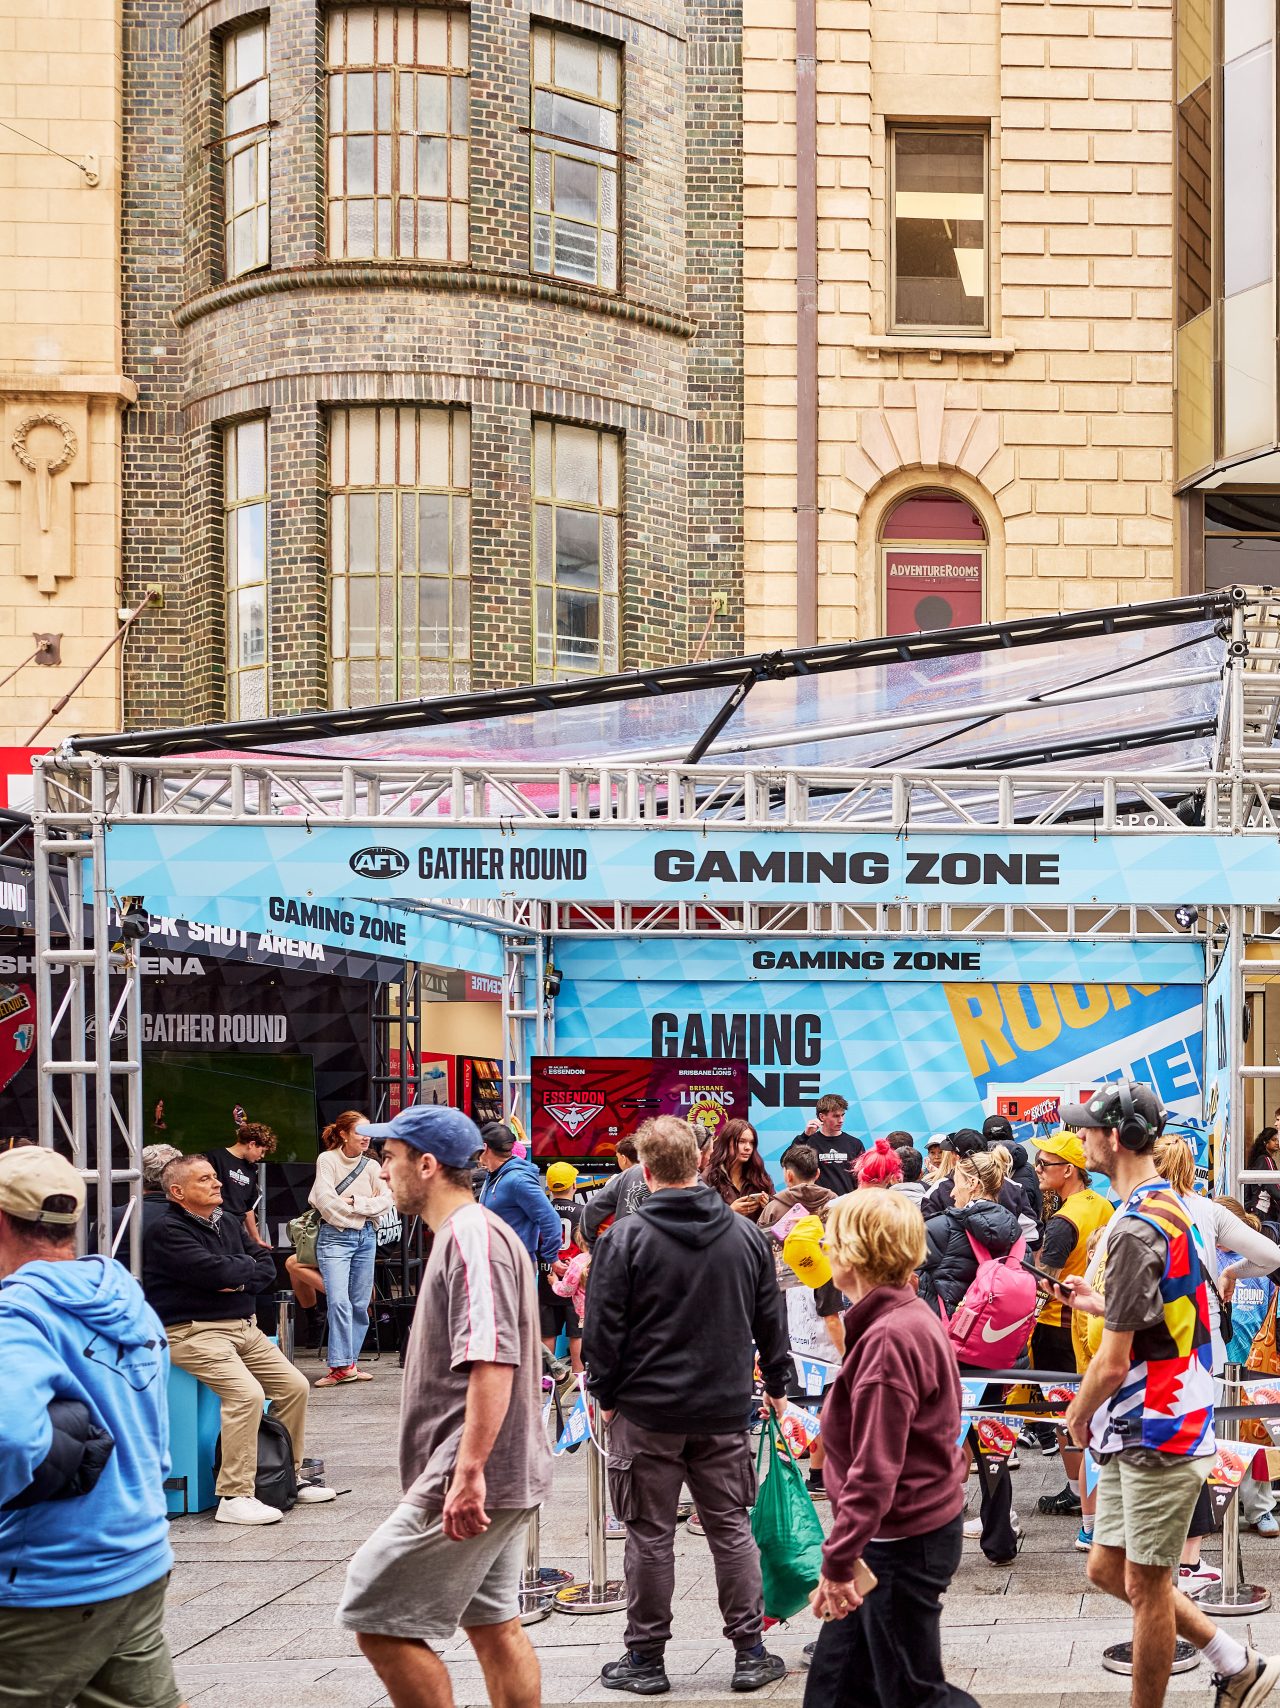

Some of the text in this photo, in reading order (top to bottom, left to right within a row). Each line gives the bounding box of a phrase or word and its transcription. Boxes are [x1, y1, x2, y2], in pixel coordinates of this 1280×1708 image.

[354, 847, 1060, 885] AFL GATHER ROUND GAMING ZONE
[269, 896, 407, 946] GAMING ZONE
[257, 933, 325, 962] ARENA
[752, 950, 981, 971] GAMING ZONE
[140, 1014, 215, 1043] GATHER
[219, 1014, 287, 1043] ROUND
[652, 1012, 822, 1067] GAMING
[543, 1091, 605, 1105] ESSENDON
[680, 1091, 735, 1106] LIONS
